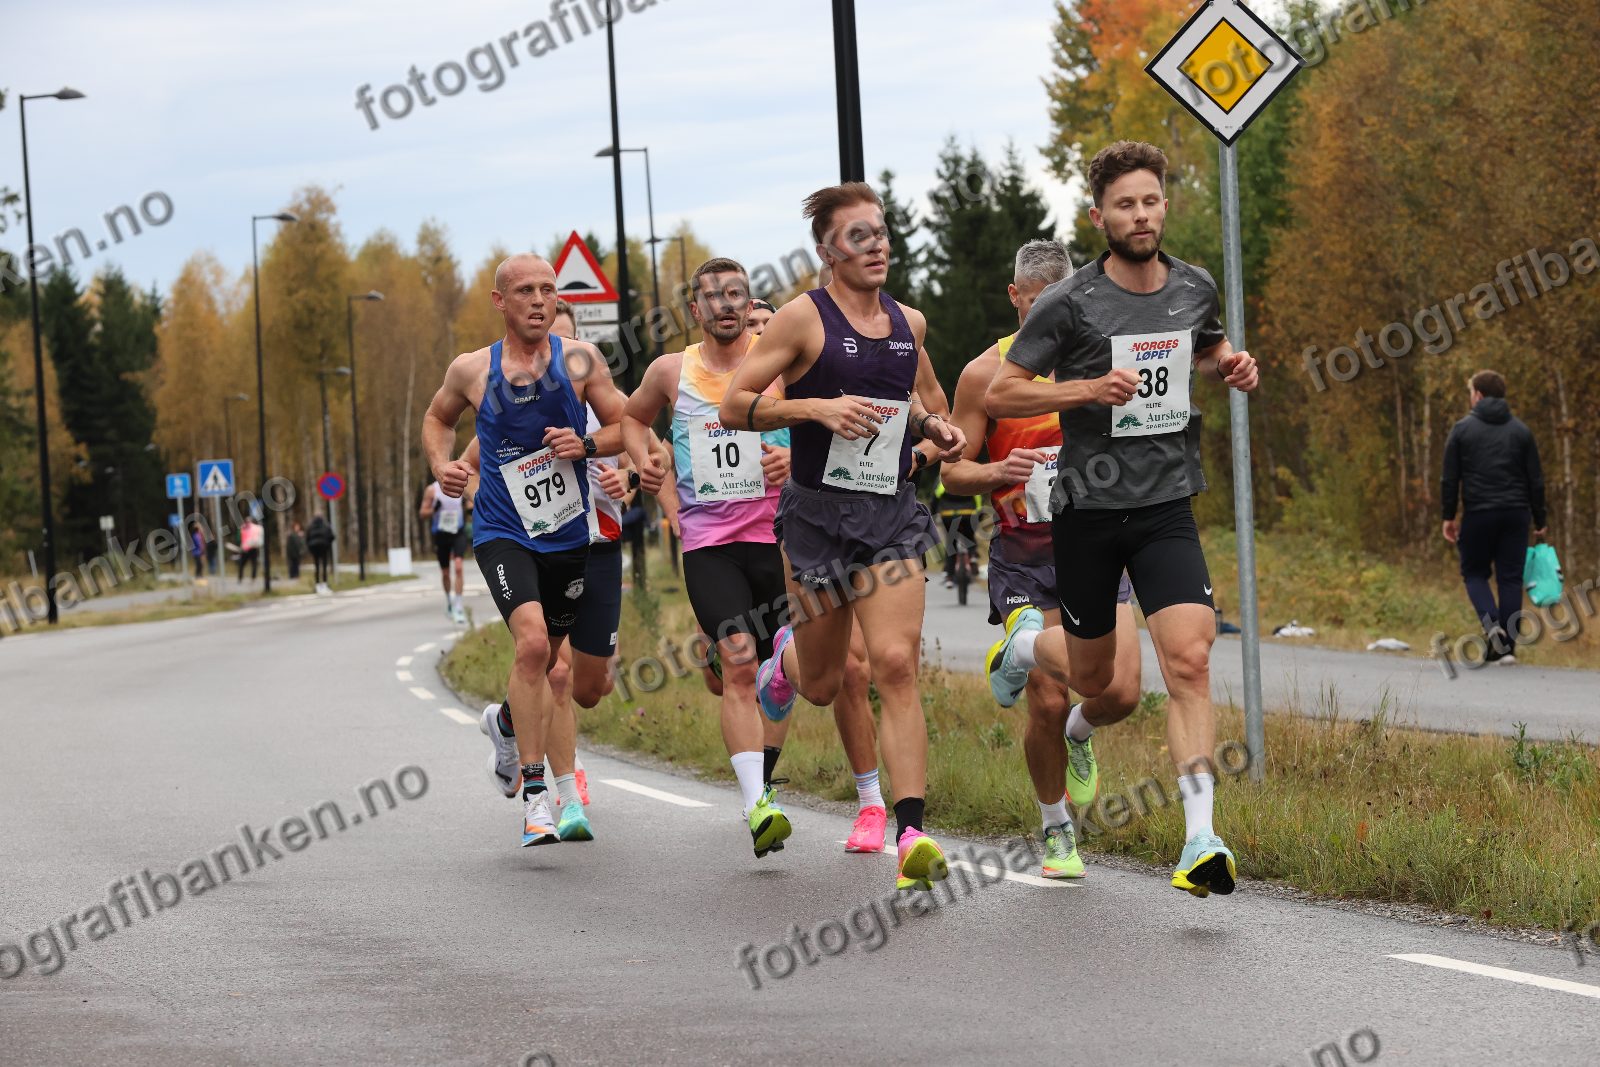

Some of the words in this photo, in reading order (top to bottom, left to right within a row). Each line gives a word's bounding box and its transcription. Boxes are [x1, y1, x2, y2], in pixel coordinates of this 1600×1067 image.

[1129, 338, 1179, 352] NORGES
[1136, 349, 1172, 361] LØPET
[1137, 366, 1169, 398] 38
[514, 395, 536, 403] CRAFT
[1146, 409, 1188, 422] Aurskog
[864, 430, 880, 456] 7
[516, 450, 557, 473] NORGES
[712, 442, 740, 468] 10
[523, 460, 553, 479] LØPET
[857, 471, 895, 485] Aurskog
[524, 472, 566, 509] 979
[722, 479, 761, 489] Aurskog
[553, 499, 582, 521] Aurskog
[496, 564, 509, 591] CRAFT
[1006, 595, 1030, 604] HOKA
